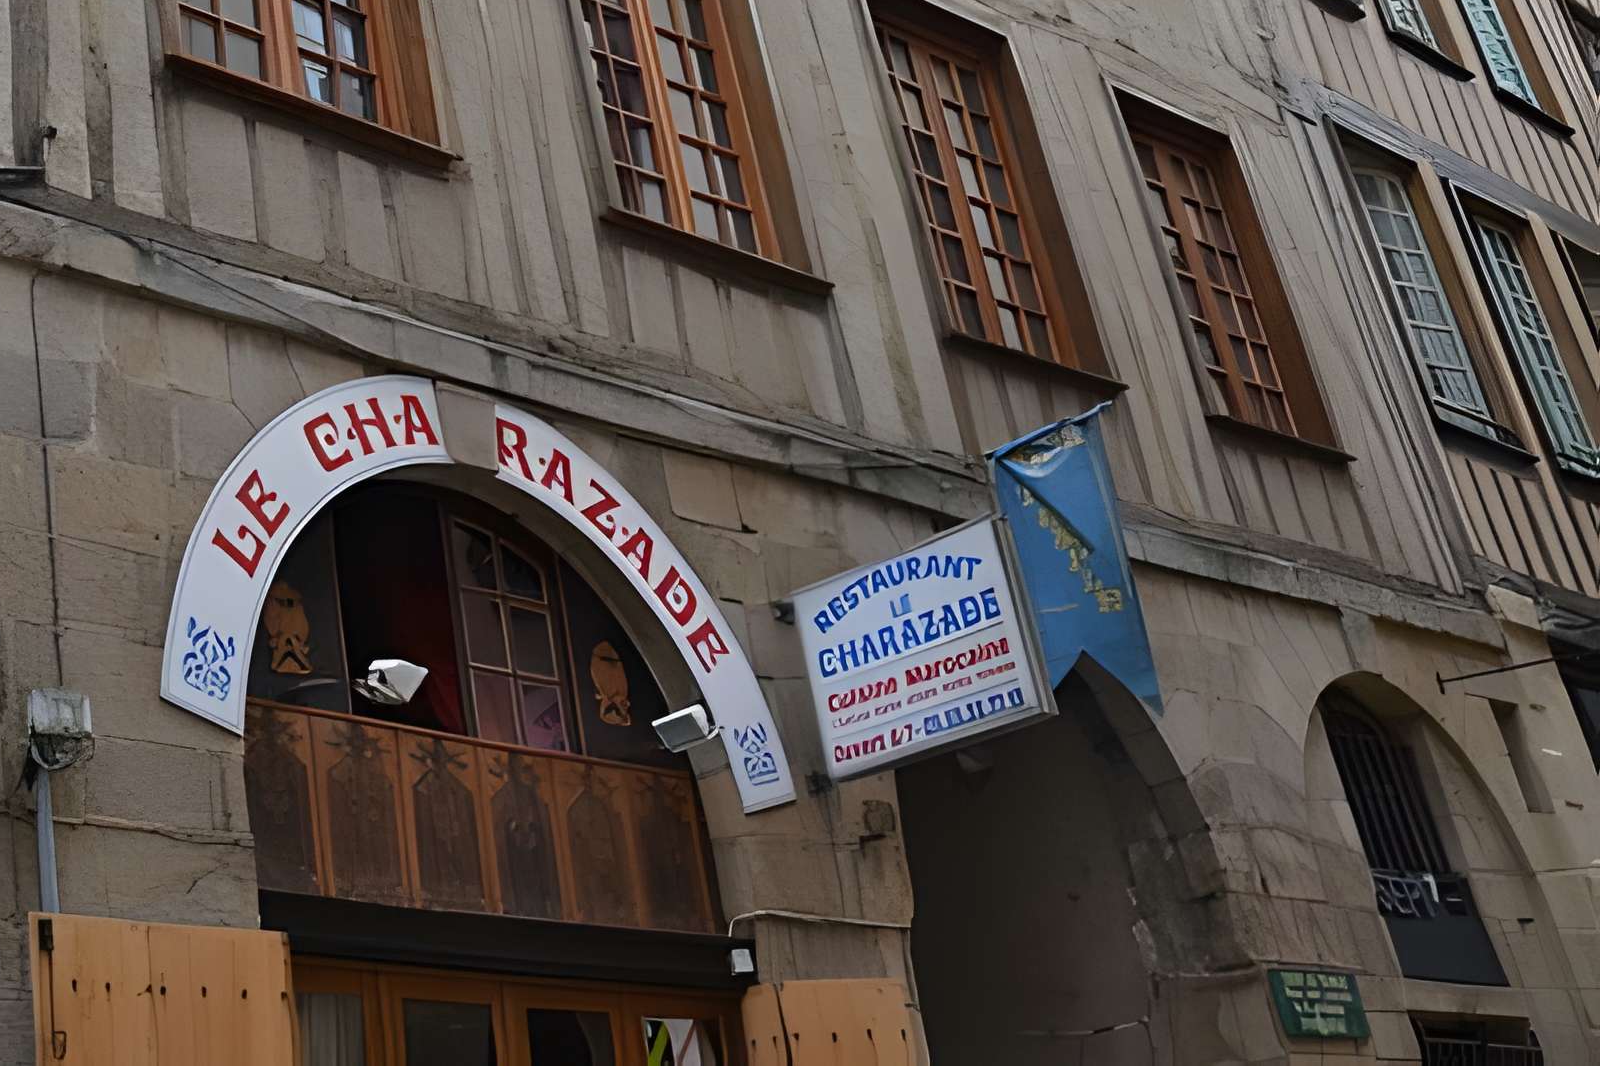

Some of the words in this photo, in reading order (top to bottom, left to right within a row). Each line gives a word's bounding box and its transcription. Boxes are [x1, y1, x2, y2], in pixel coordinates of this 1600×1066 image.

[212, 469, 290, 578] LE
[813, 554, 983, 634] RESTAURANT
[818, 586, 1001, 678] CHARAZADE
